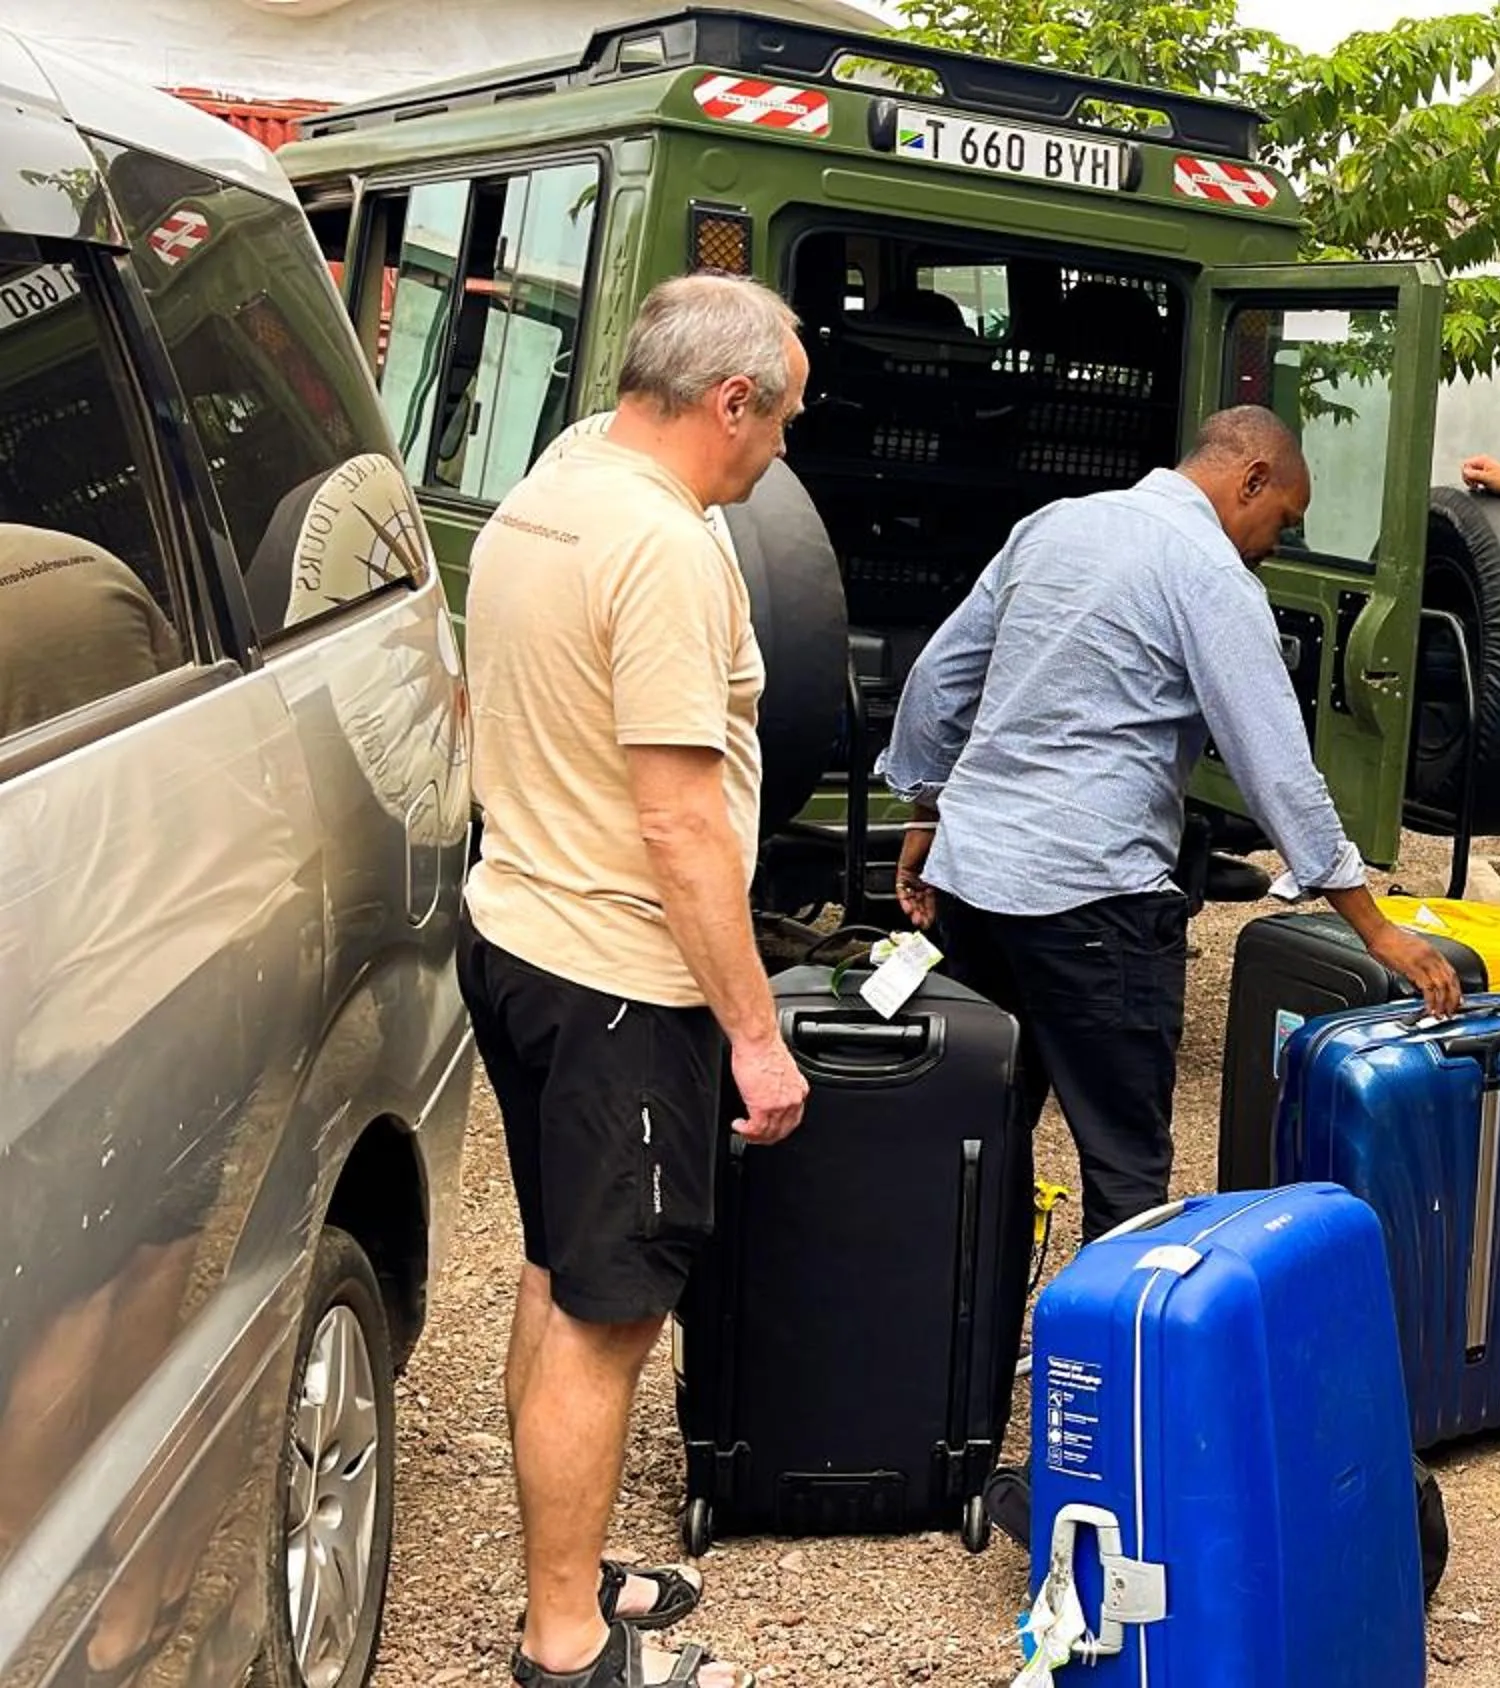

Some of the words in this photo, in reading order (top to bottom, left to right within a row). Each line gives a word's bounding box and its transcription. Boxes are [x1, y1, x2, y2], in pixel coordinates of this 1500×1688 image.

[926, 119, 945, 159] T
[960, 126, 1025, 173] 660
[1045, 138, 1109, 187] BYH
